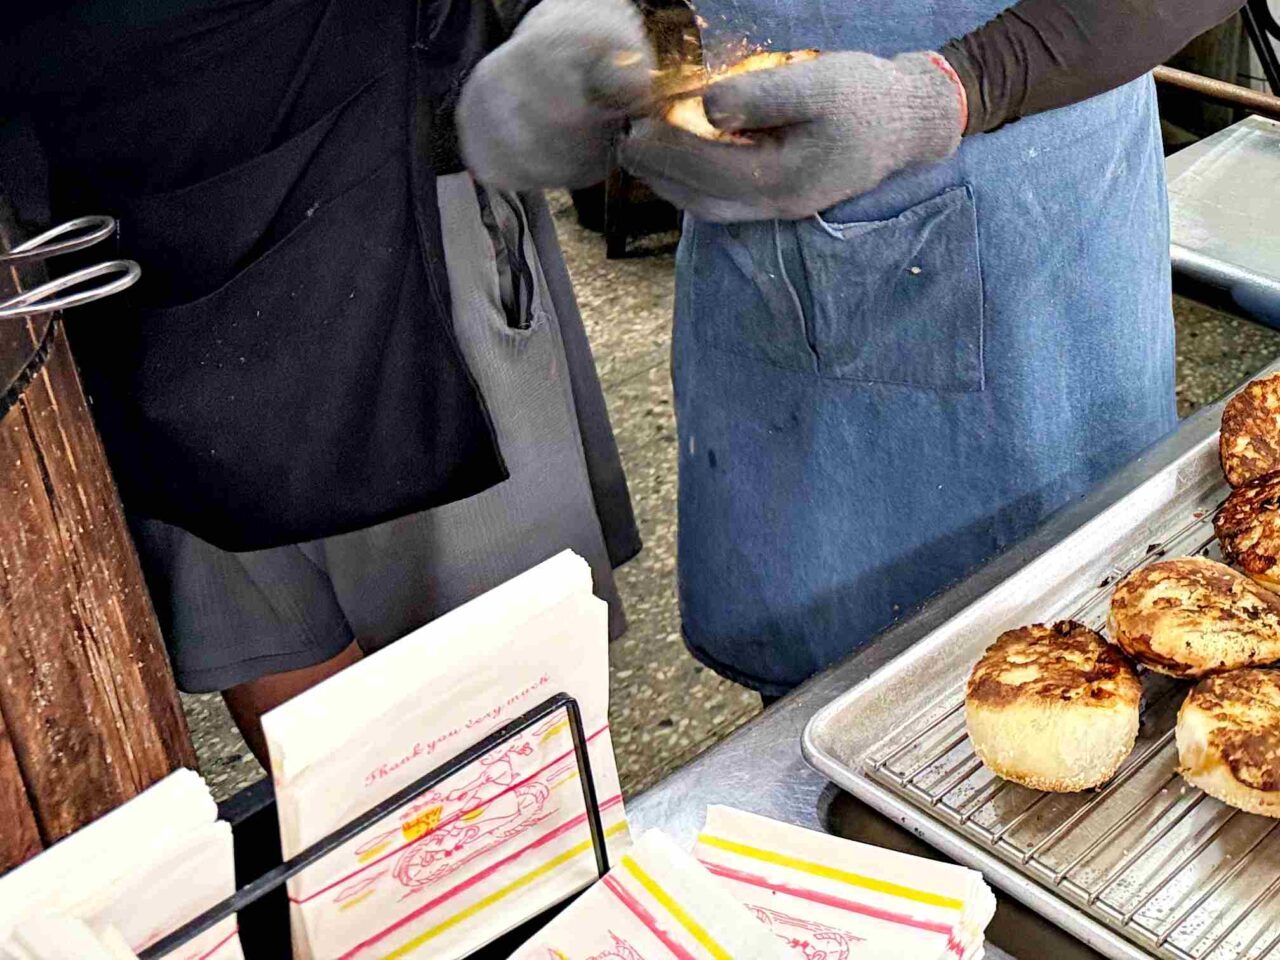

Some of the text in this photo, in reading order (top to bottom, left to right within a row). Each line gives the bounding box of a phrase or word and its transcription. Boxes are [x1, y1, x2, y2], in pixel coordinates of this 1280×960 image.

[364, 672, 550, 787] Thank you very much
